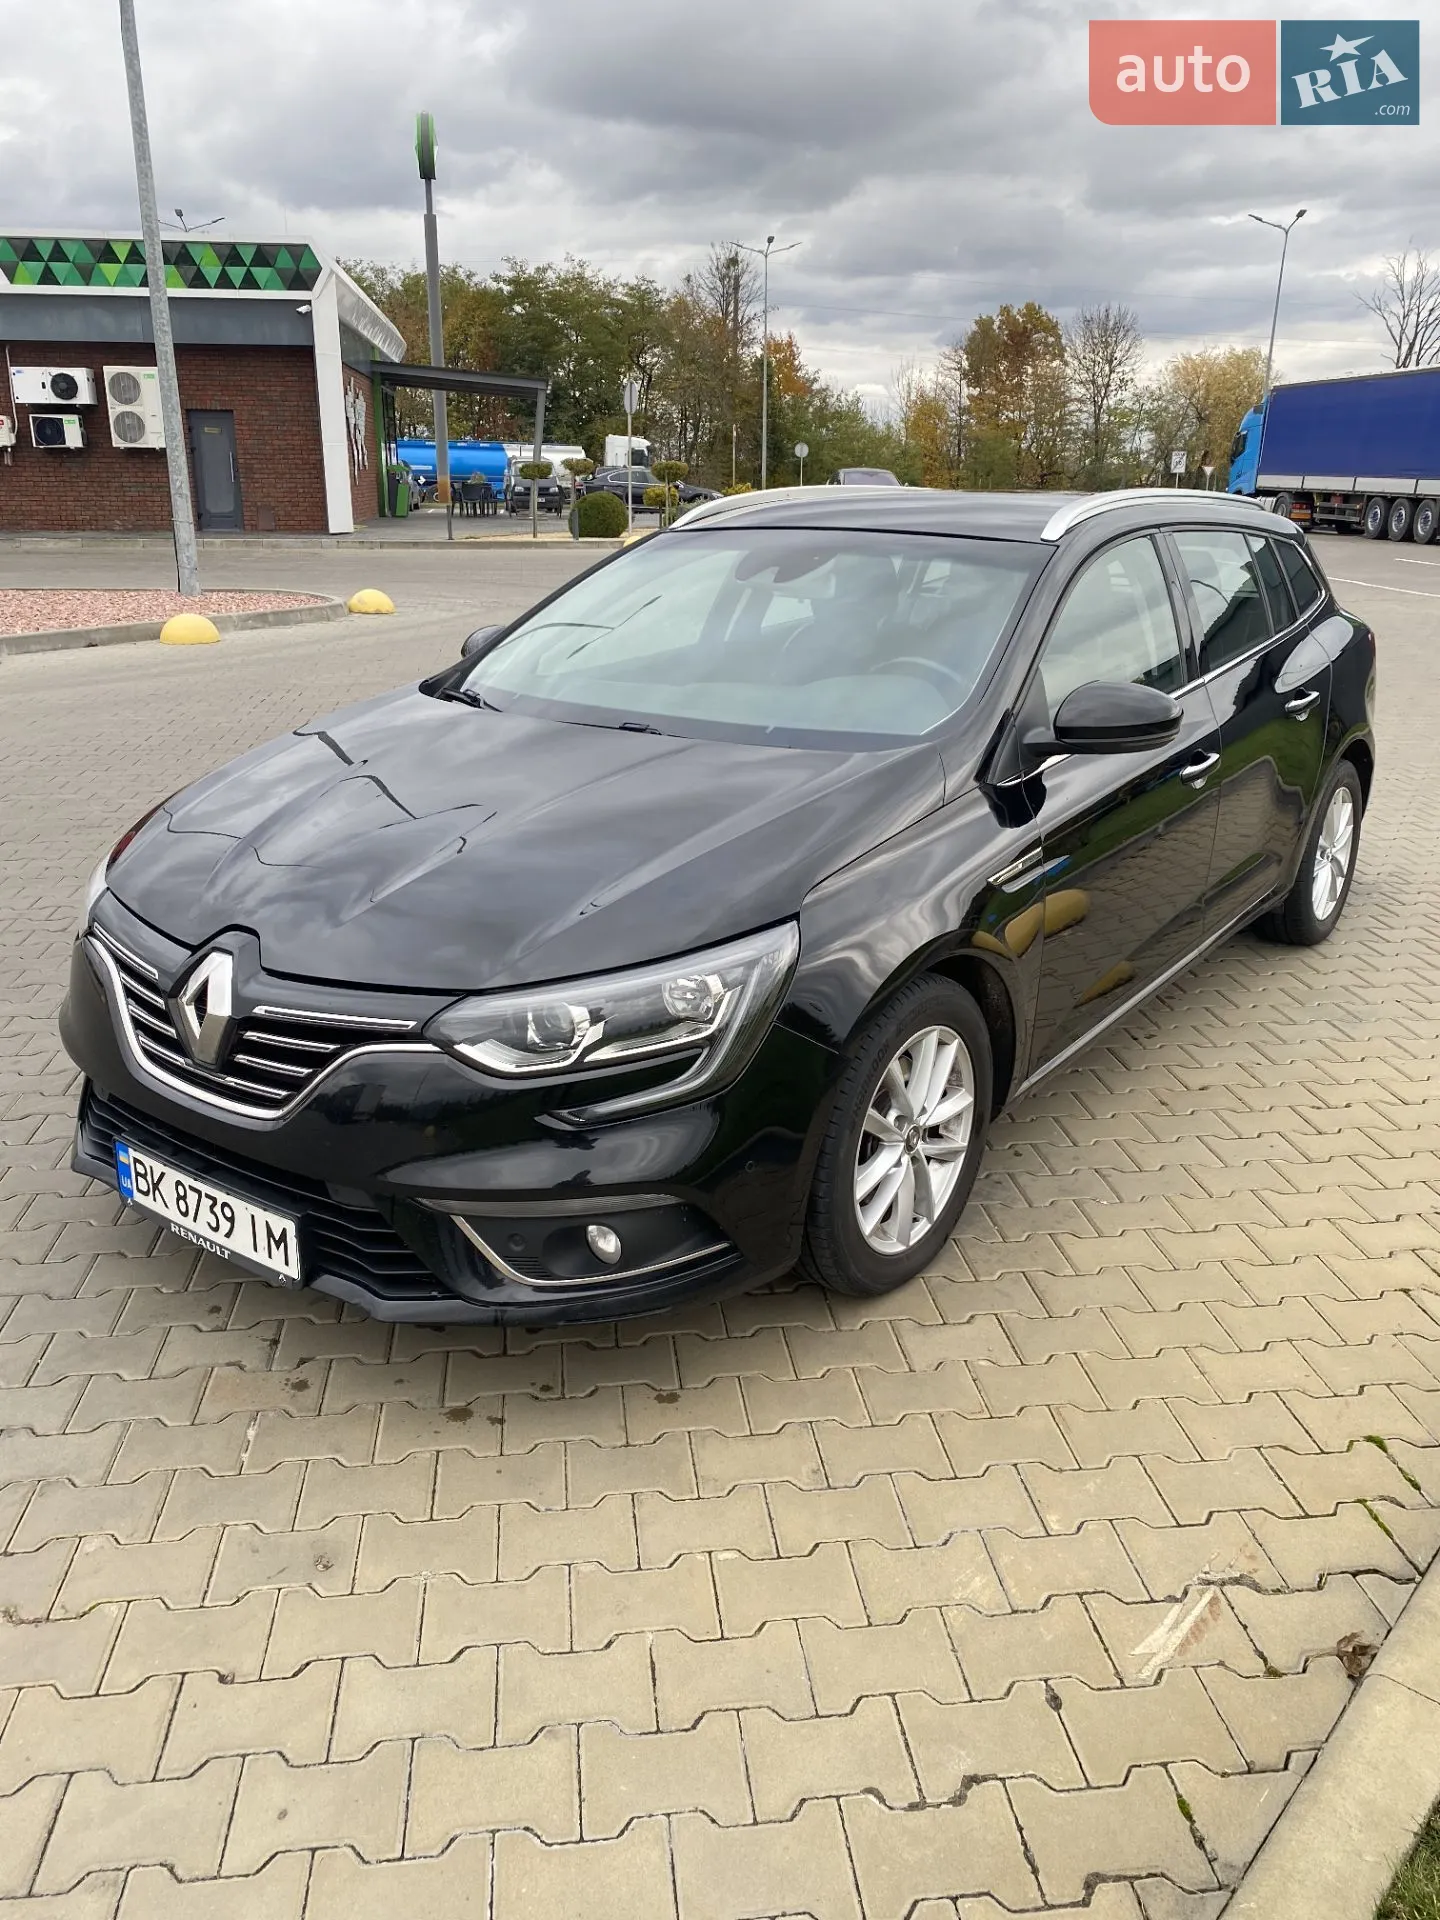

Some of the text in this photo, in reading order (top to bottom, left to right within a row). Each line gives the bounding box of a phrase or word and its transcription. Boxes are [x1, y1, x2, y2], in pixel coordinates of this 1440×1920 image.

[121, 1176, 132, 1190] UA
[133, 1157, 289, 1267] BK 8739 IM
[170, 1223, 231, 1260] RENAULT
